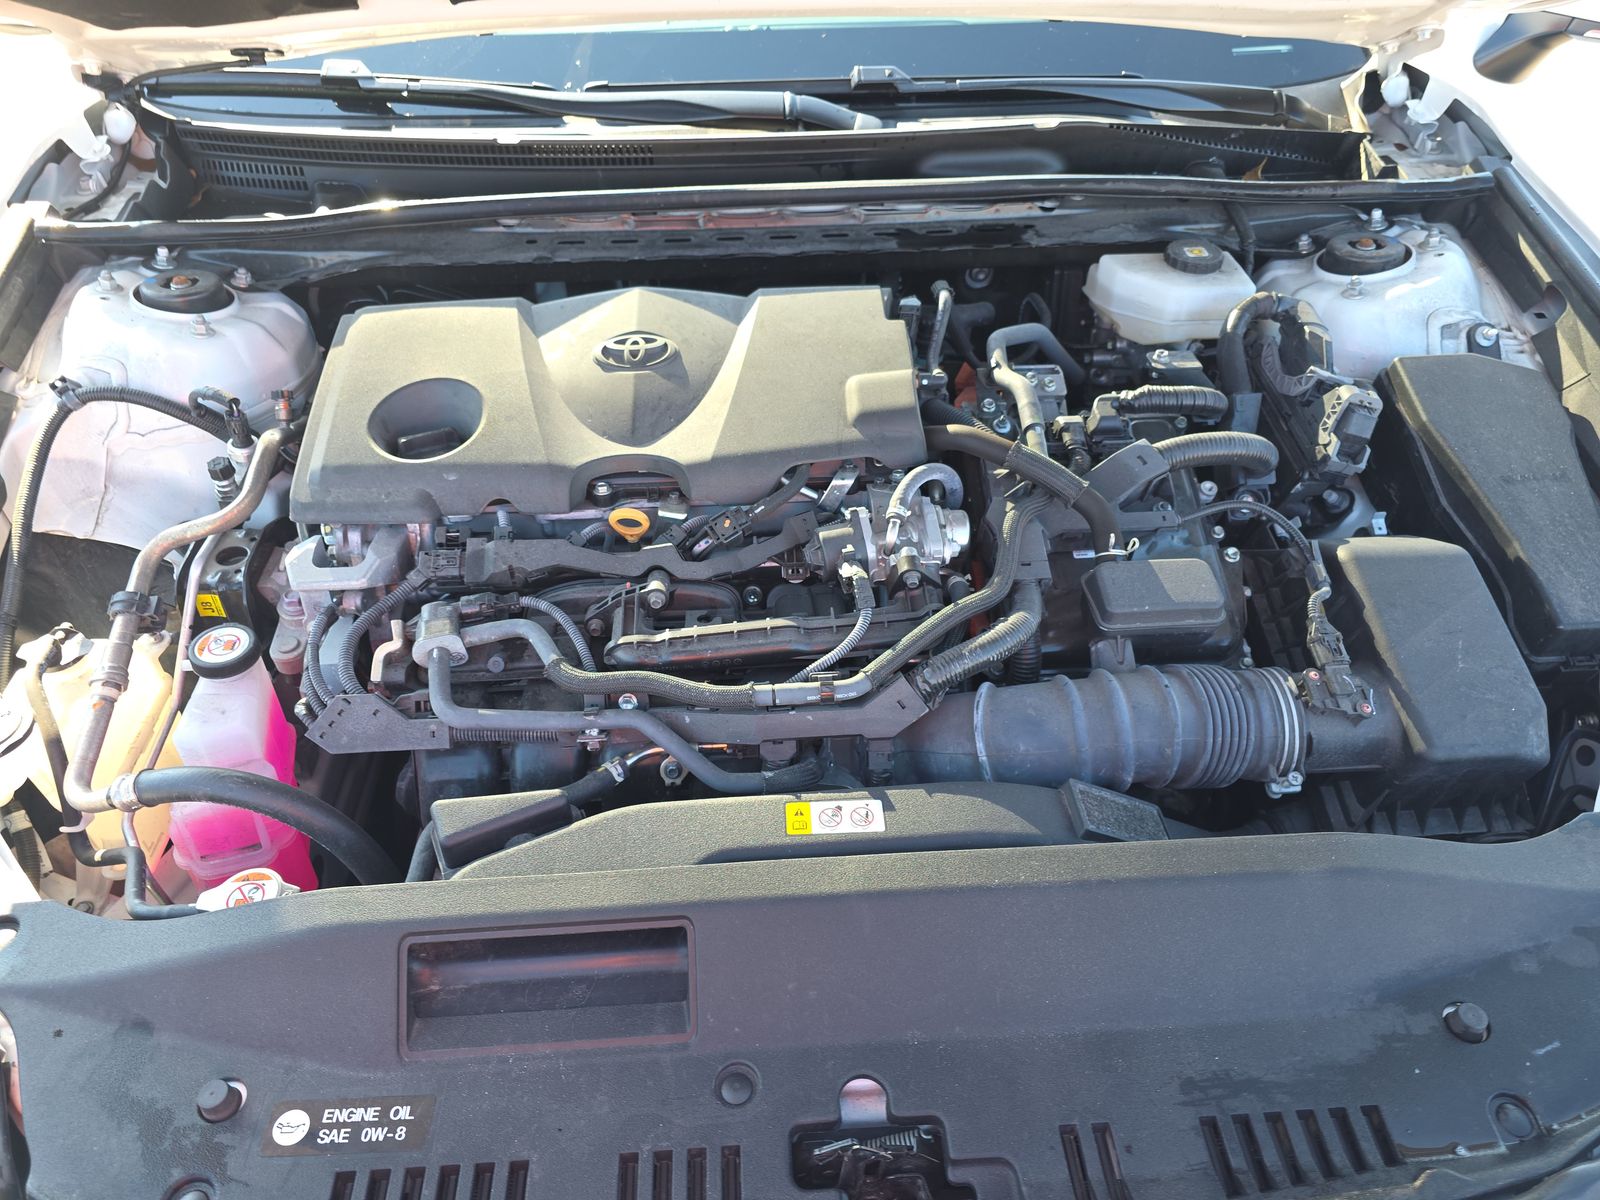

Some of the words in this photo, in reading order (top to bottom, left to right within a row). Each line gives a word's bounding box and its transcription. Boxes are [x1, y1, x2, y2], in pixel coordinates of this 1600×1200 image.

[322, 1107, 381, 1123] ENGINE
[389, 1105, 415, 1121] OIL
[316, 1128, 351, 1144] SAE
[361, 1126, 406, 1143] 0W-8
